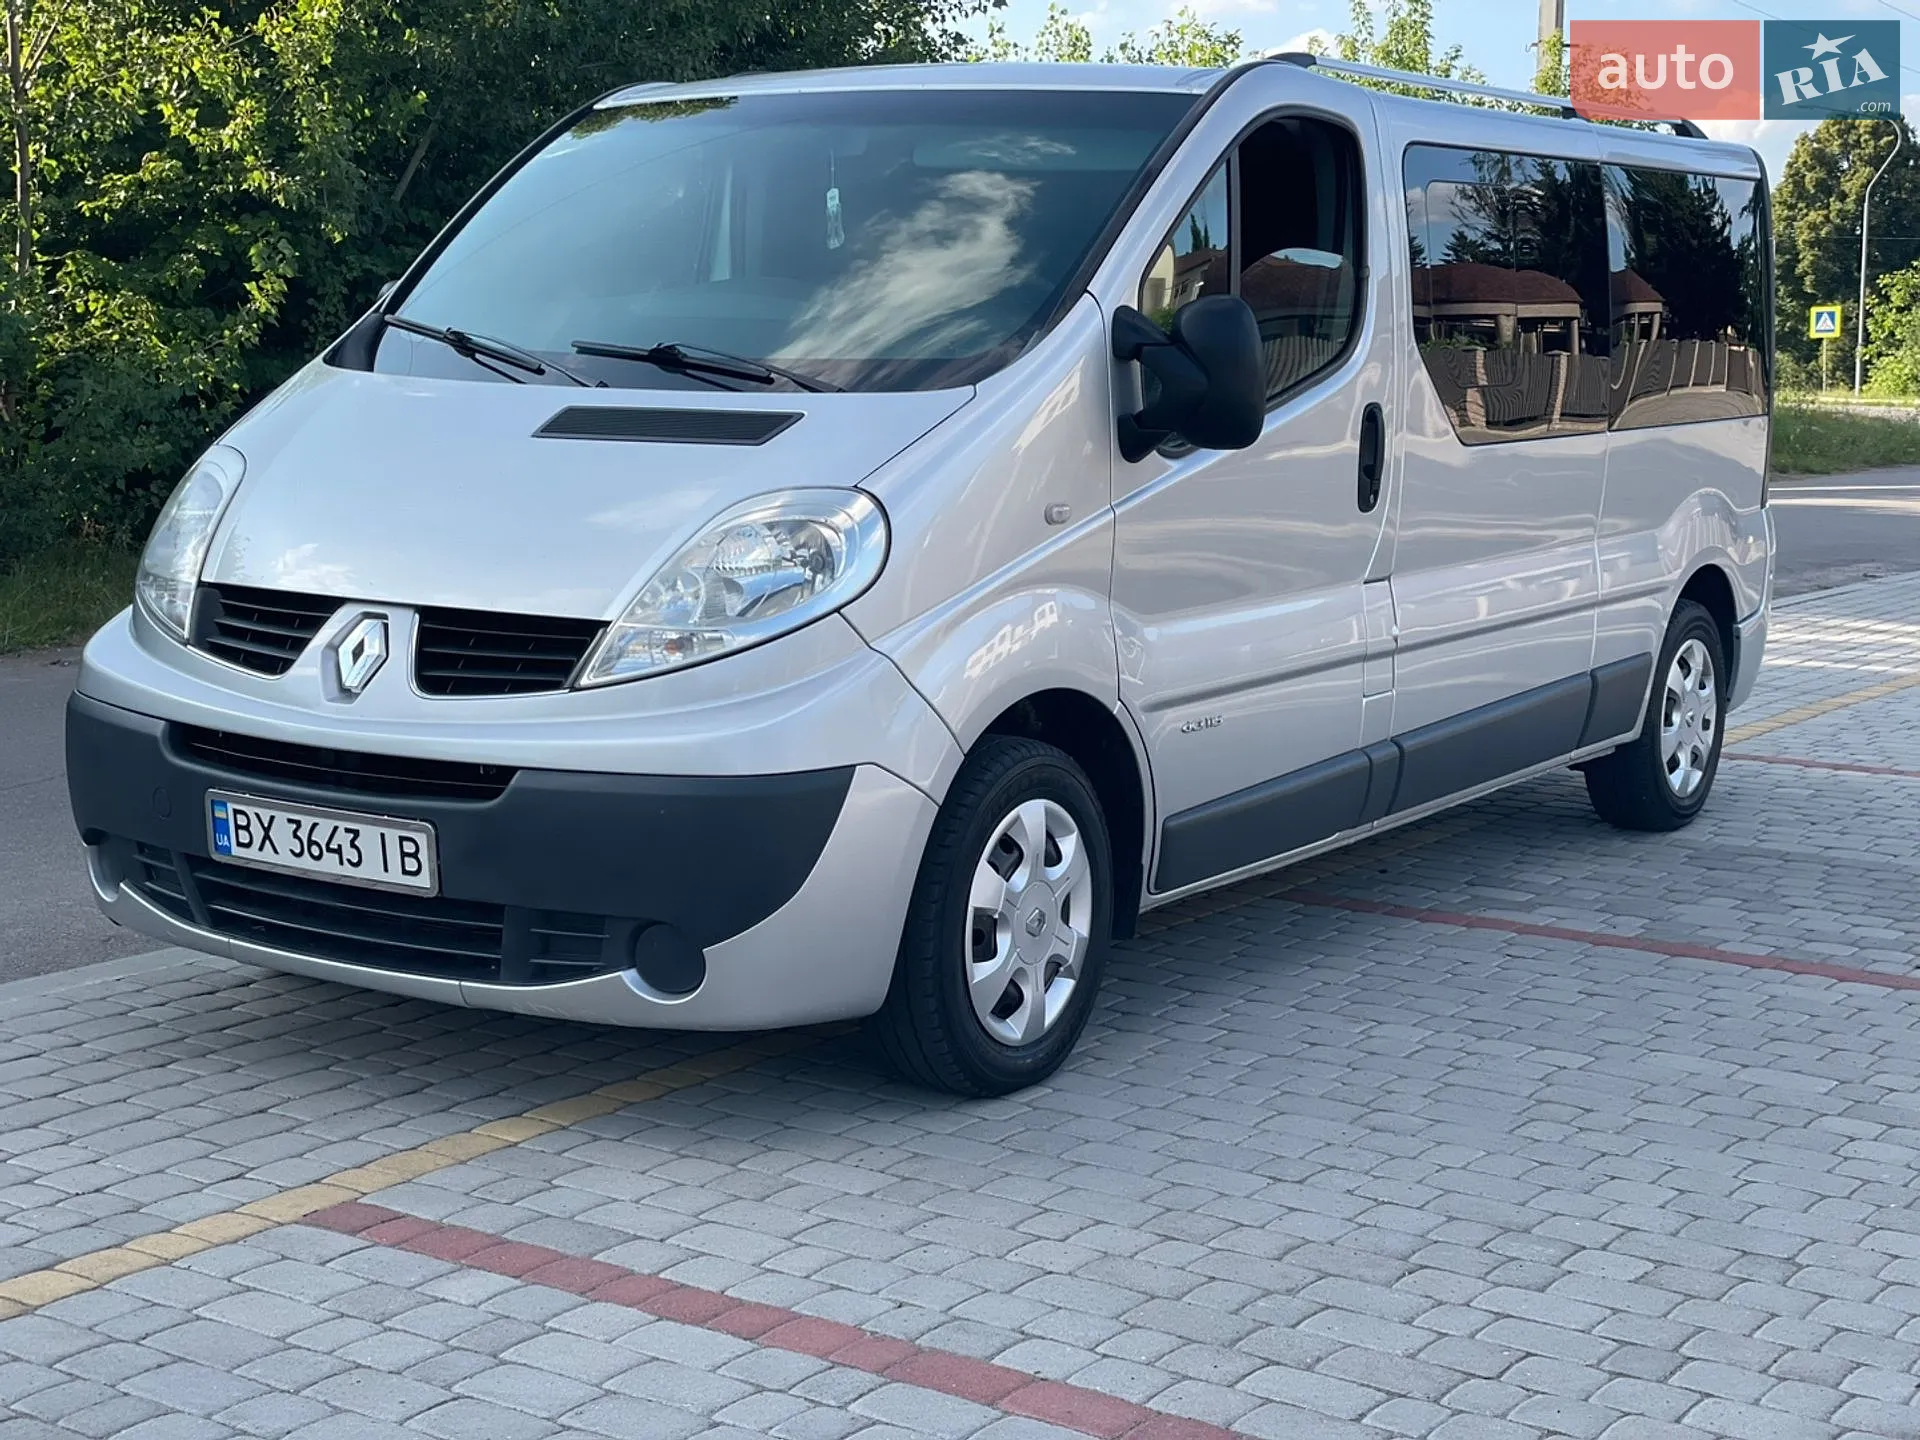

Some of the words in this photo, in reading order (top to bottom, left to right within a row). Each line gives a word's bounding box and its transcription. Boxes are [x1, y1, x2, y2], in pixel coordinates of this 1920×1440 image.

[216, 833, 230, 847] UA
[232, 808, 279, 855] BX
[286, 818, 363, 868] 3643
[379, 832, 423, 876] IB
